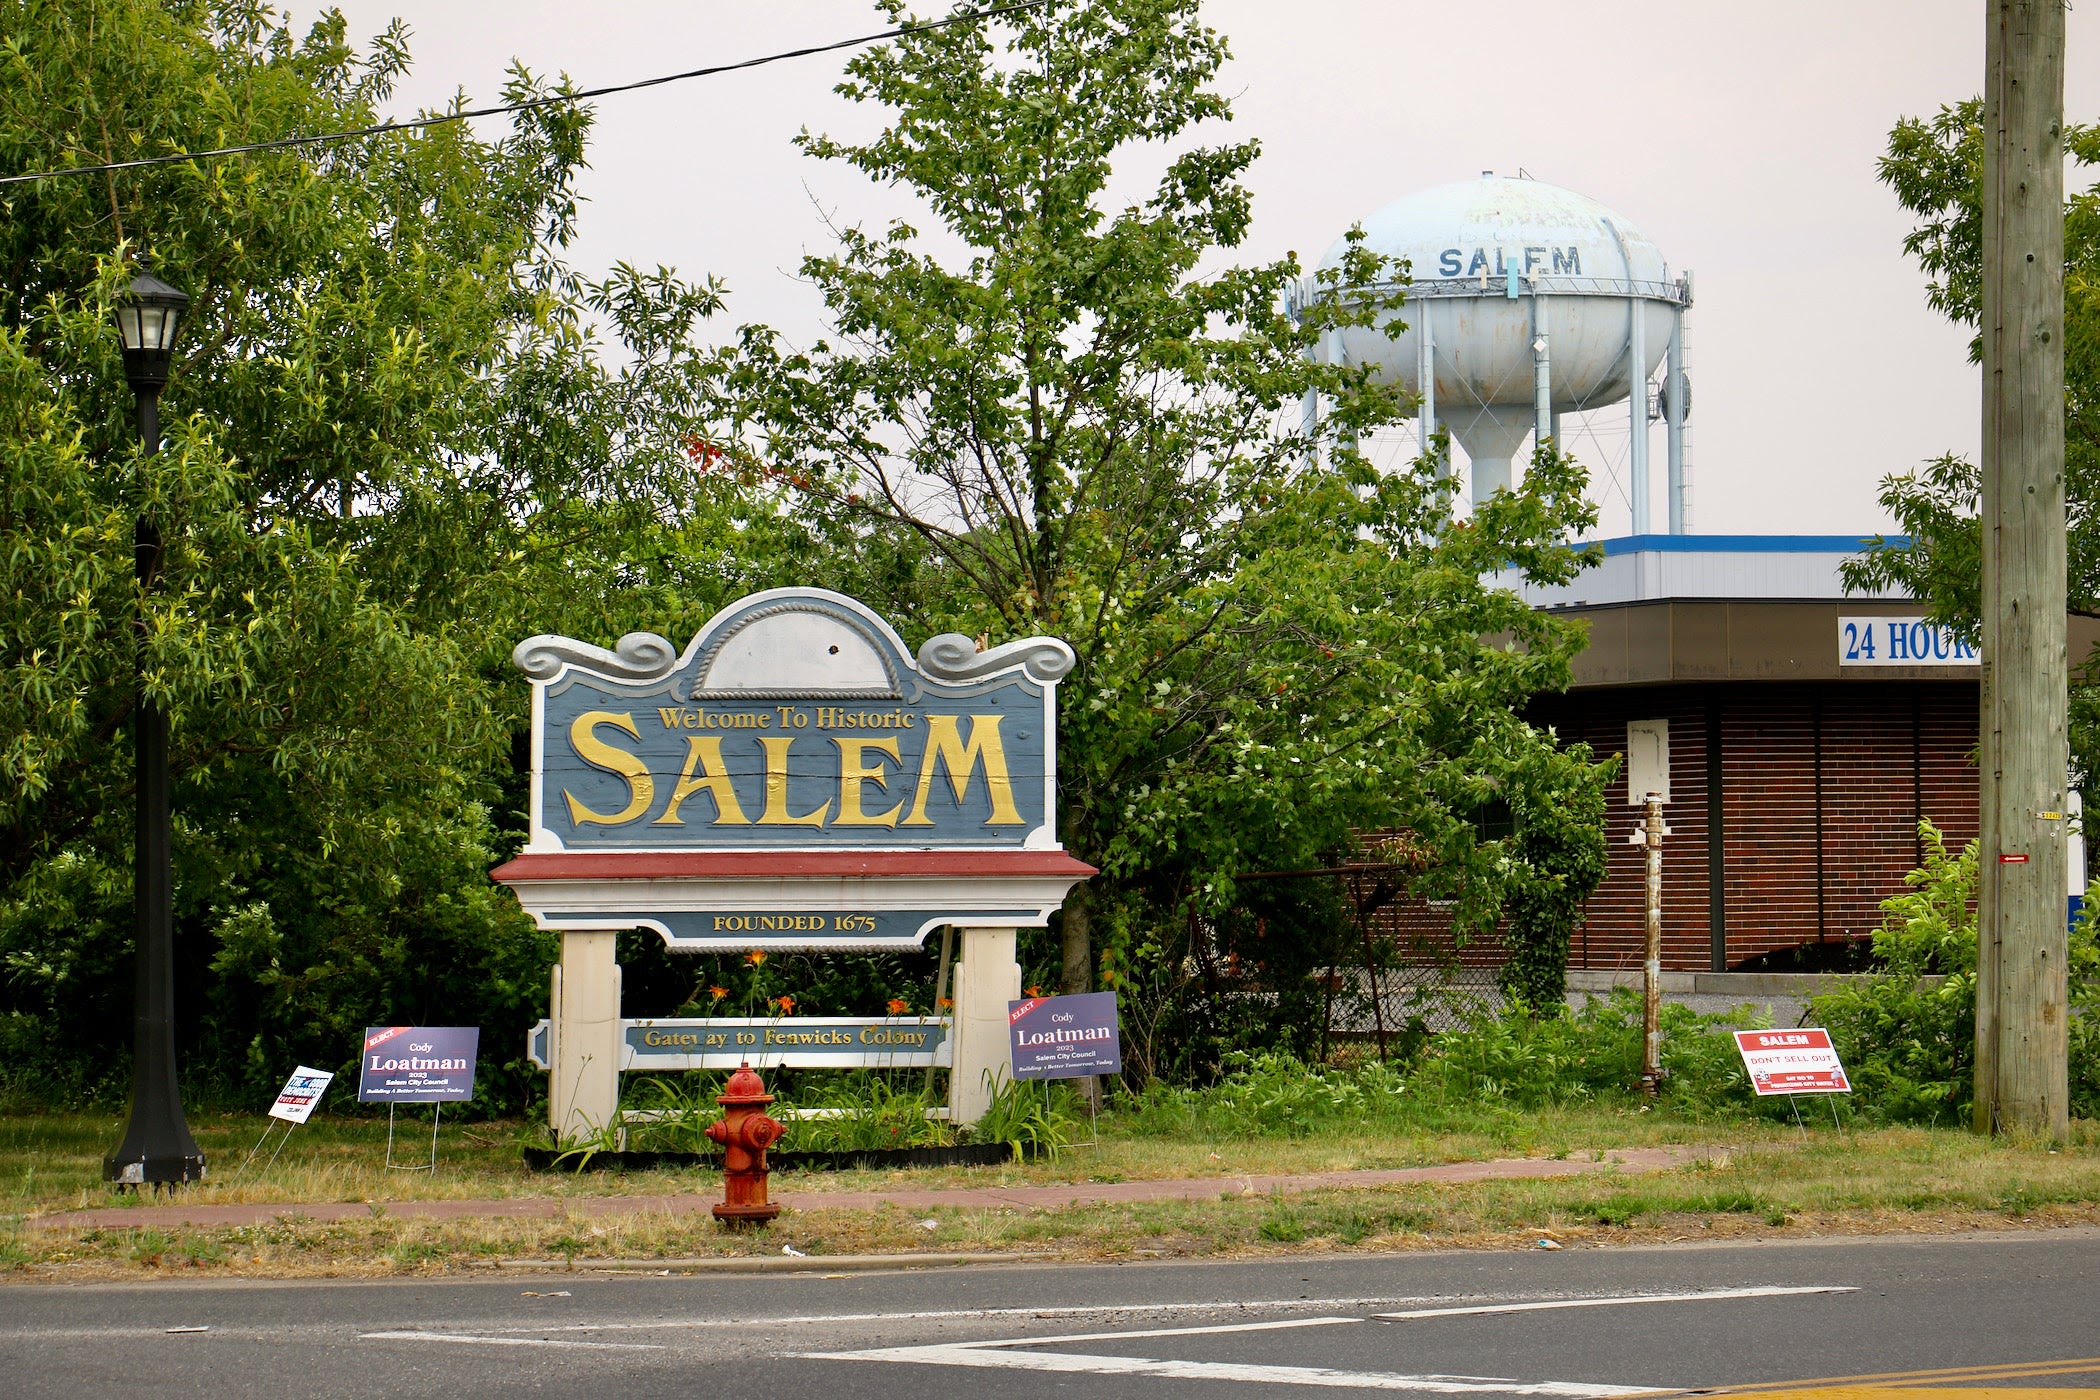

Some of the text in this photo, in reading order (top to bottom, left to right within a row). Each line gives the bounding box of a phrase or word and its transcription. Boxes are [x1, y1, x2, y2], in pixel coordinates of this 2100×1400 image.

[1438, 246, 1582, 277] SALEM
[1845, 622, 1876, 660] 24
[657, 705, 915, 729] Welcome To Historic
[561, 711, 1027, 830] SALEM
[713, 914, 877, 933] FOUNDED 1675
[1011, 1000, 1035, 1020] ELECT
[1051, 1012, 1074, 1024] Cody
[368, 1028, 395, 1047] ELECT
[736, 1031, 757, 1046] to
[764, 1028, 852, 1045] Fenwicks
[859, 1027, 927, 1048] Colony
[1017, 1026, 1111, 1046] Loatman
[1759, 1034, 1810, 1047] SALEM
[409, 1042, 433, 1054] Cody
[1035, 1050, 1096, 1062] Salem City Council
[369, 1055, 467, 1071] Loatman
[1750, 1054, 1832, 1065] DON'T SELL OUT
[408, 1079, 422, 1087] City
[423, 1078, 449, 1086] Council
